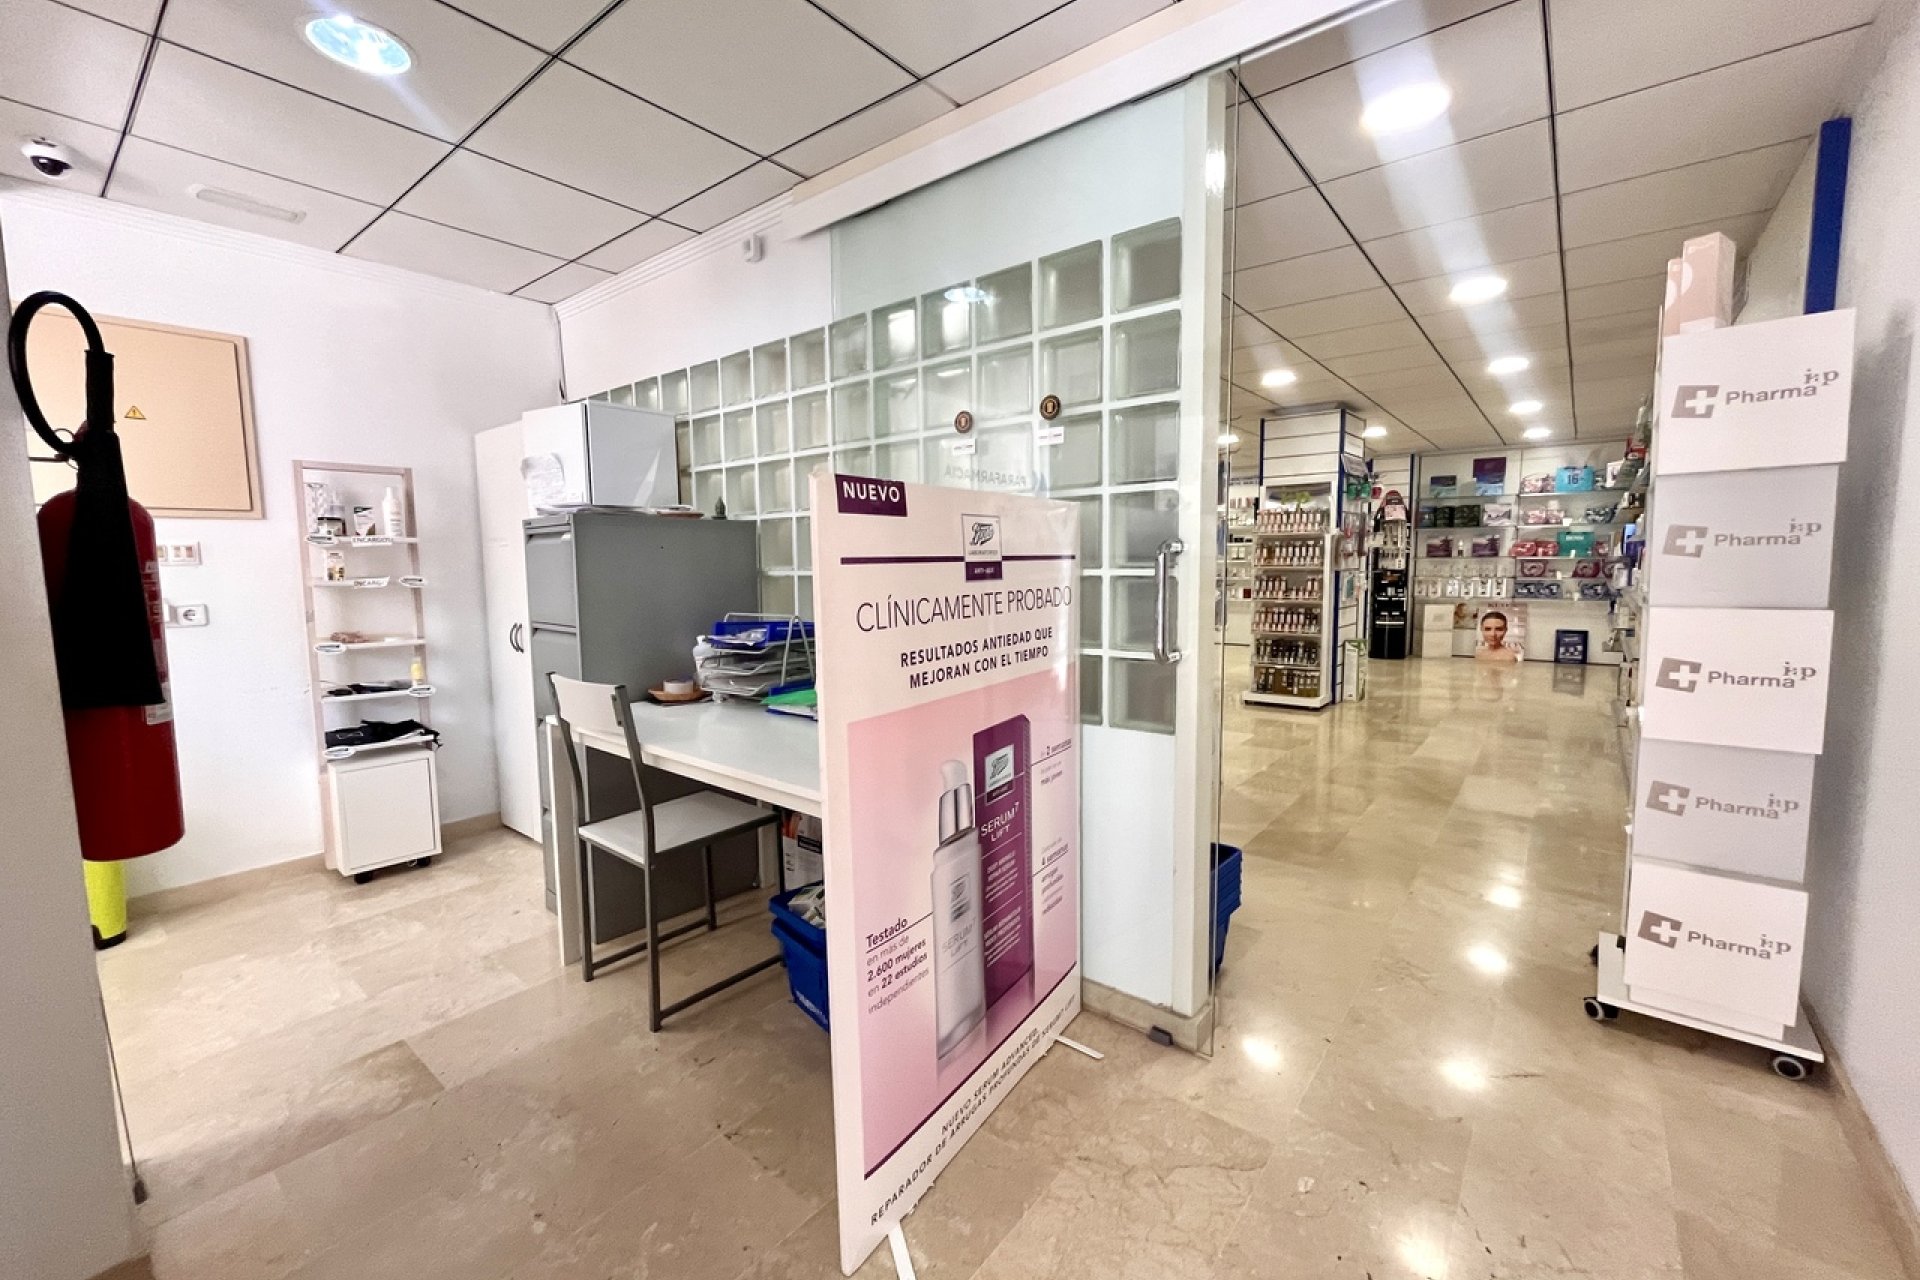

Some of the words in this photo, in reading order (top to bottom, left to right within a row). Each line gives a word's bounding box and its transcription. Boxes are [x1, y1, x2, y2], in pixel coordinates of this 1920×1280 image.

[1725, 384, 1817, 406] Pharma
[843, 481, 900, 503] NUEVO
[1714, 533, 1801, 547] Pharma
[856, 591, 1003, 632] CLÍNICAMENTE
[1007, 585, 1072, 612] PROBADO
[900, 639, 979, 668] RESULTADOS
[982, 630, 1031, 651] ANTIEDAD
[1034, 626, 1053, 641] QUE
[909, 662, 970, 689] MEJORAN
[974, 656, 997, 672] CON
[1001, 654, 1012, 667] EL
[1015, 646, 1048, 664] TIEMPO
[1708, 670, 1796, 689] Pharma
[1695, 796, 1779, 819] Pharma
[866, 918, 908, 947] Testado
[1687, 930, 1771, 960] Pharma
[867, 954, 878, 966] en
[867, 958, 893, 982] 2.600
[895, 939, 926, 965] mujeres
[868, 984, 880, 998] en
[882, 974, 892, 989] 22
[894, 952, 928, 980] estudios
[868, 966, 929, 1014] independientes
[942, 1098, 971, 1136] NUEVO
[974, 1067, 1000, 1100] SERUM
[871, 1154, 932, 1226] REPARADOR
[936, 1138, 946, 1156] DE
[950, 1092, 987, 1140] ARRUGAS
[989, 1047, 1030, 1095] PROFUNDAS
